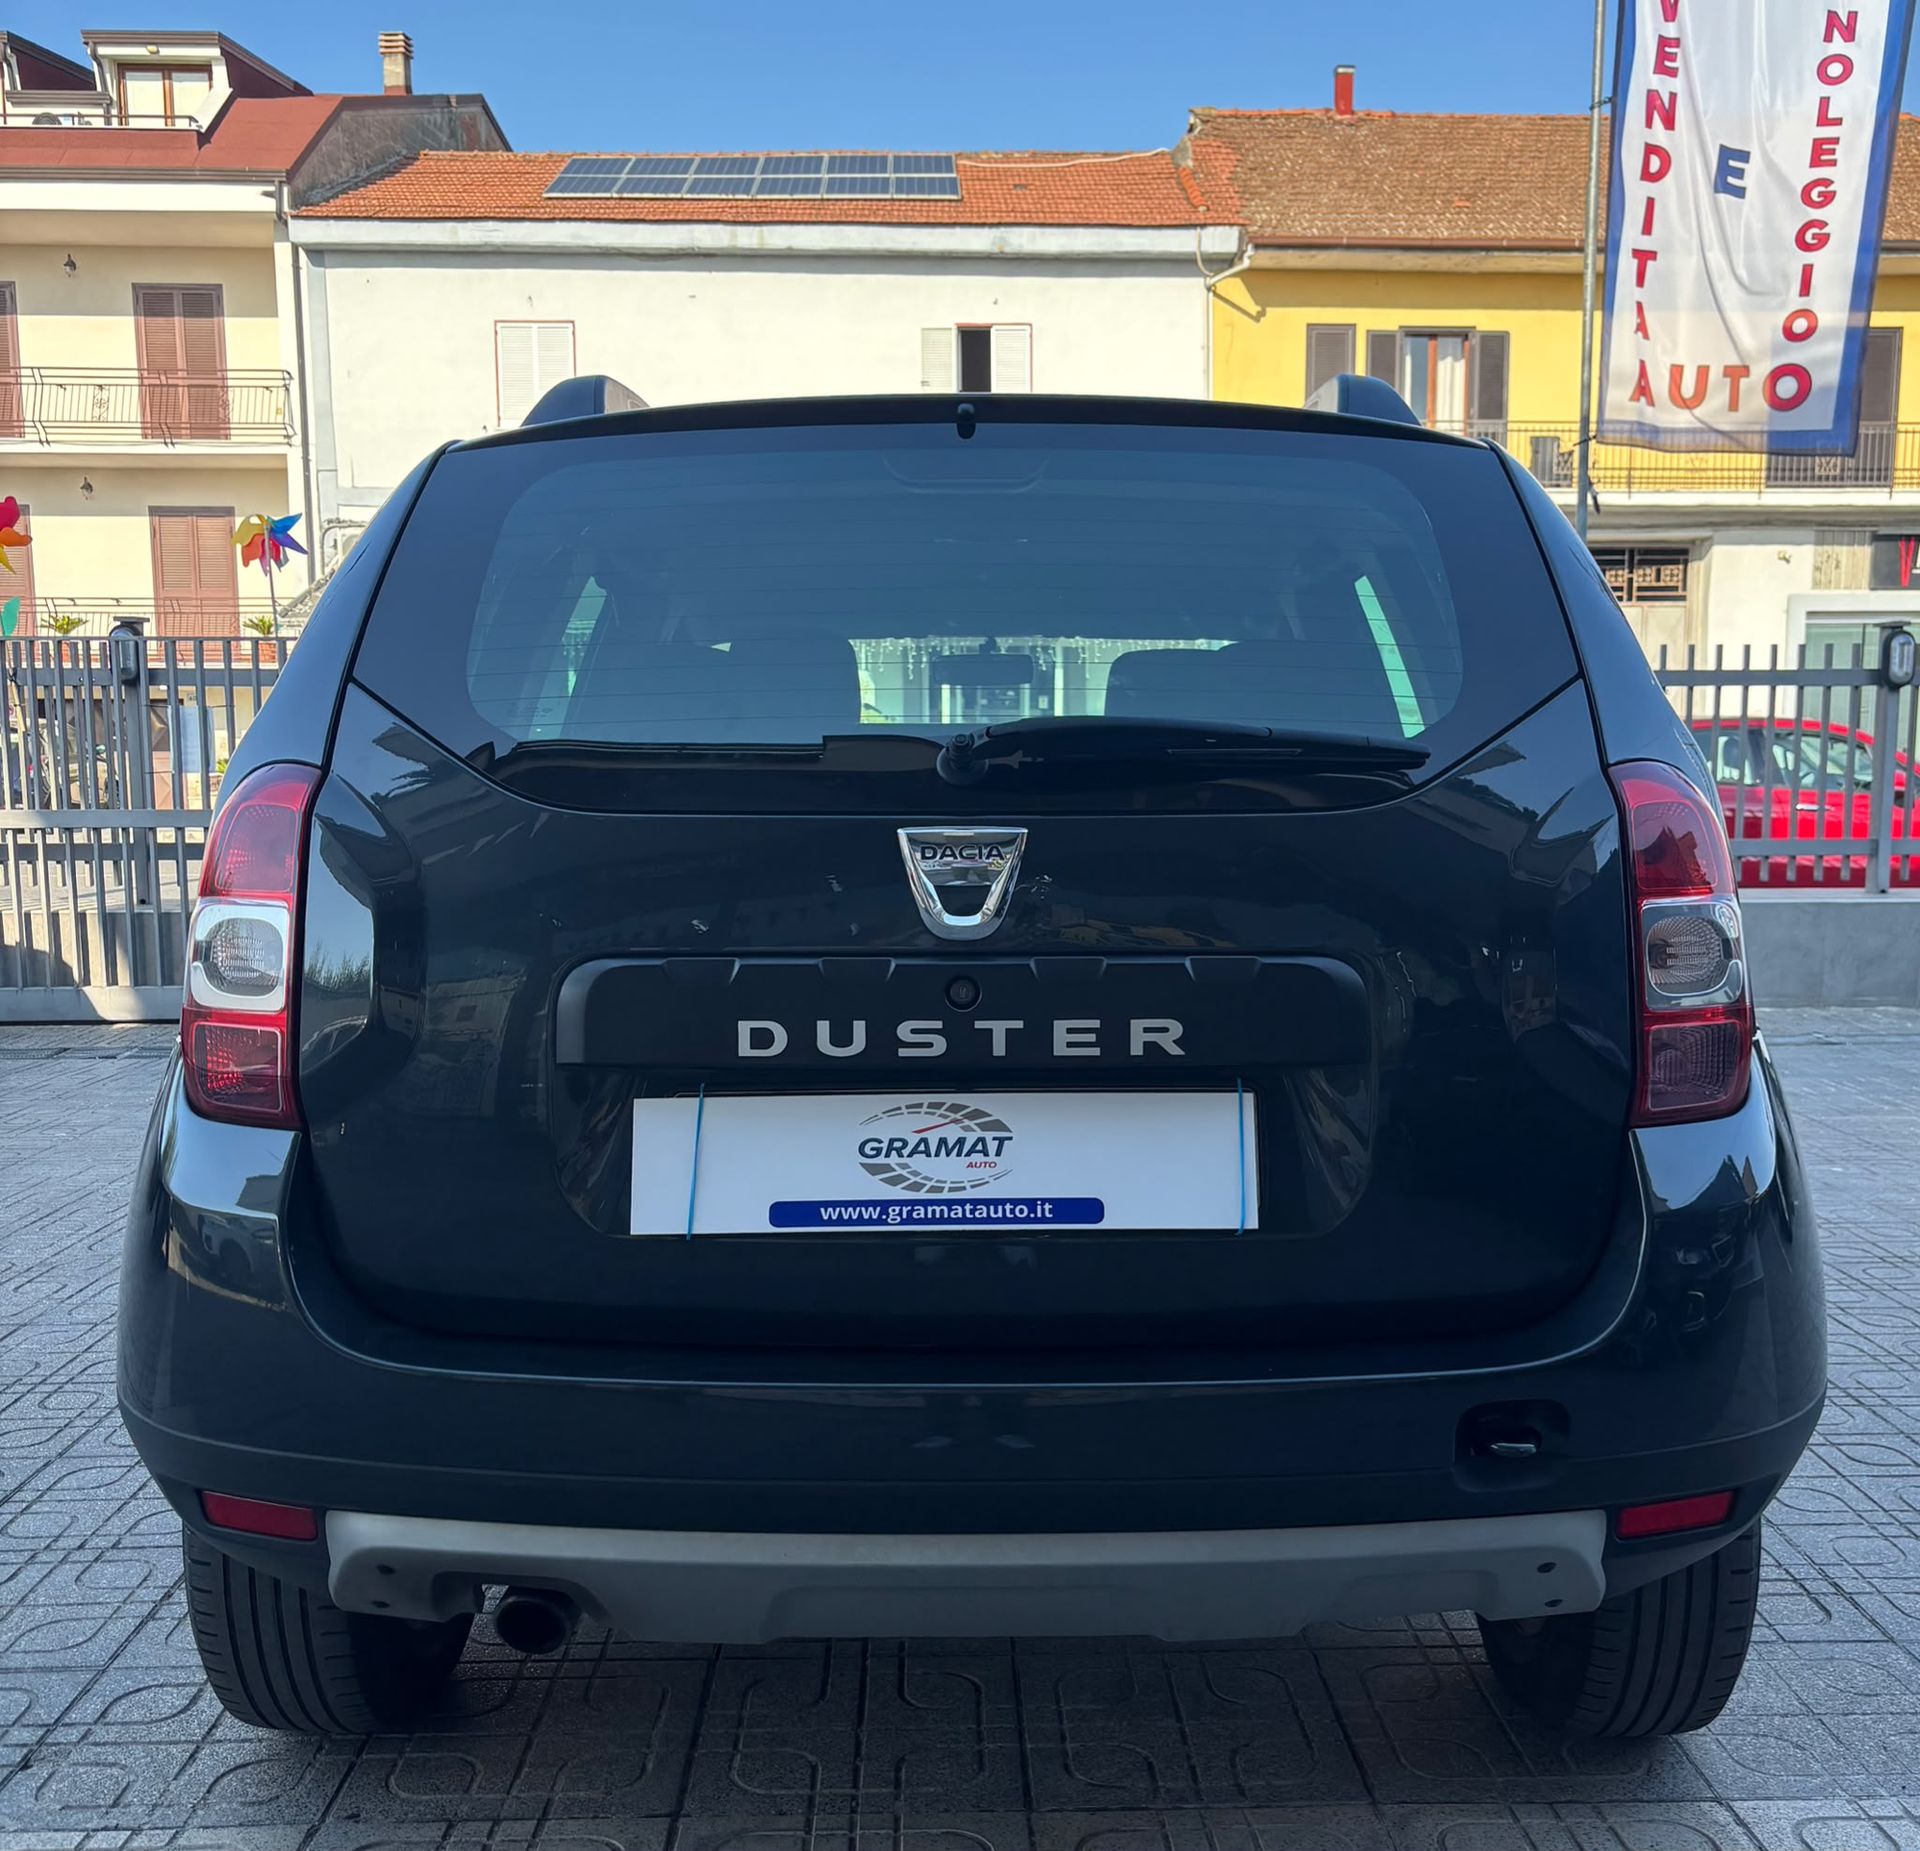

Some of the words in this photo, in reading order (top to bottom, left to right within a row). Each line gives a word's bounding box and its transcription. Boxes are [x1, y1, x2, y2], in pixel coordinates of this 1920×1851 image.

[1631, 0, 1681, 341] VENDITA
[1714, 144, 1751, 199] E
[1782, 9, 1858, 343] NOLEGGIO
[1629, 358, 1812, 412] AUTO
[919, 844, 1006, 861] DACIA
[737, 1018, 1186, 1057] DUSTER
[858, 1136, 1014, 1159] GRAMAT
[966, 1160, 998, 1169] AUTO
[820, 1200, 1054, 1224] www.gramatauto.it
